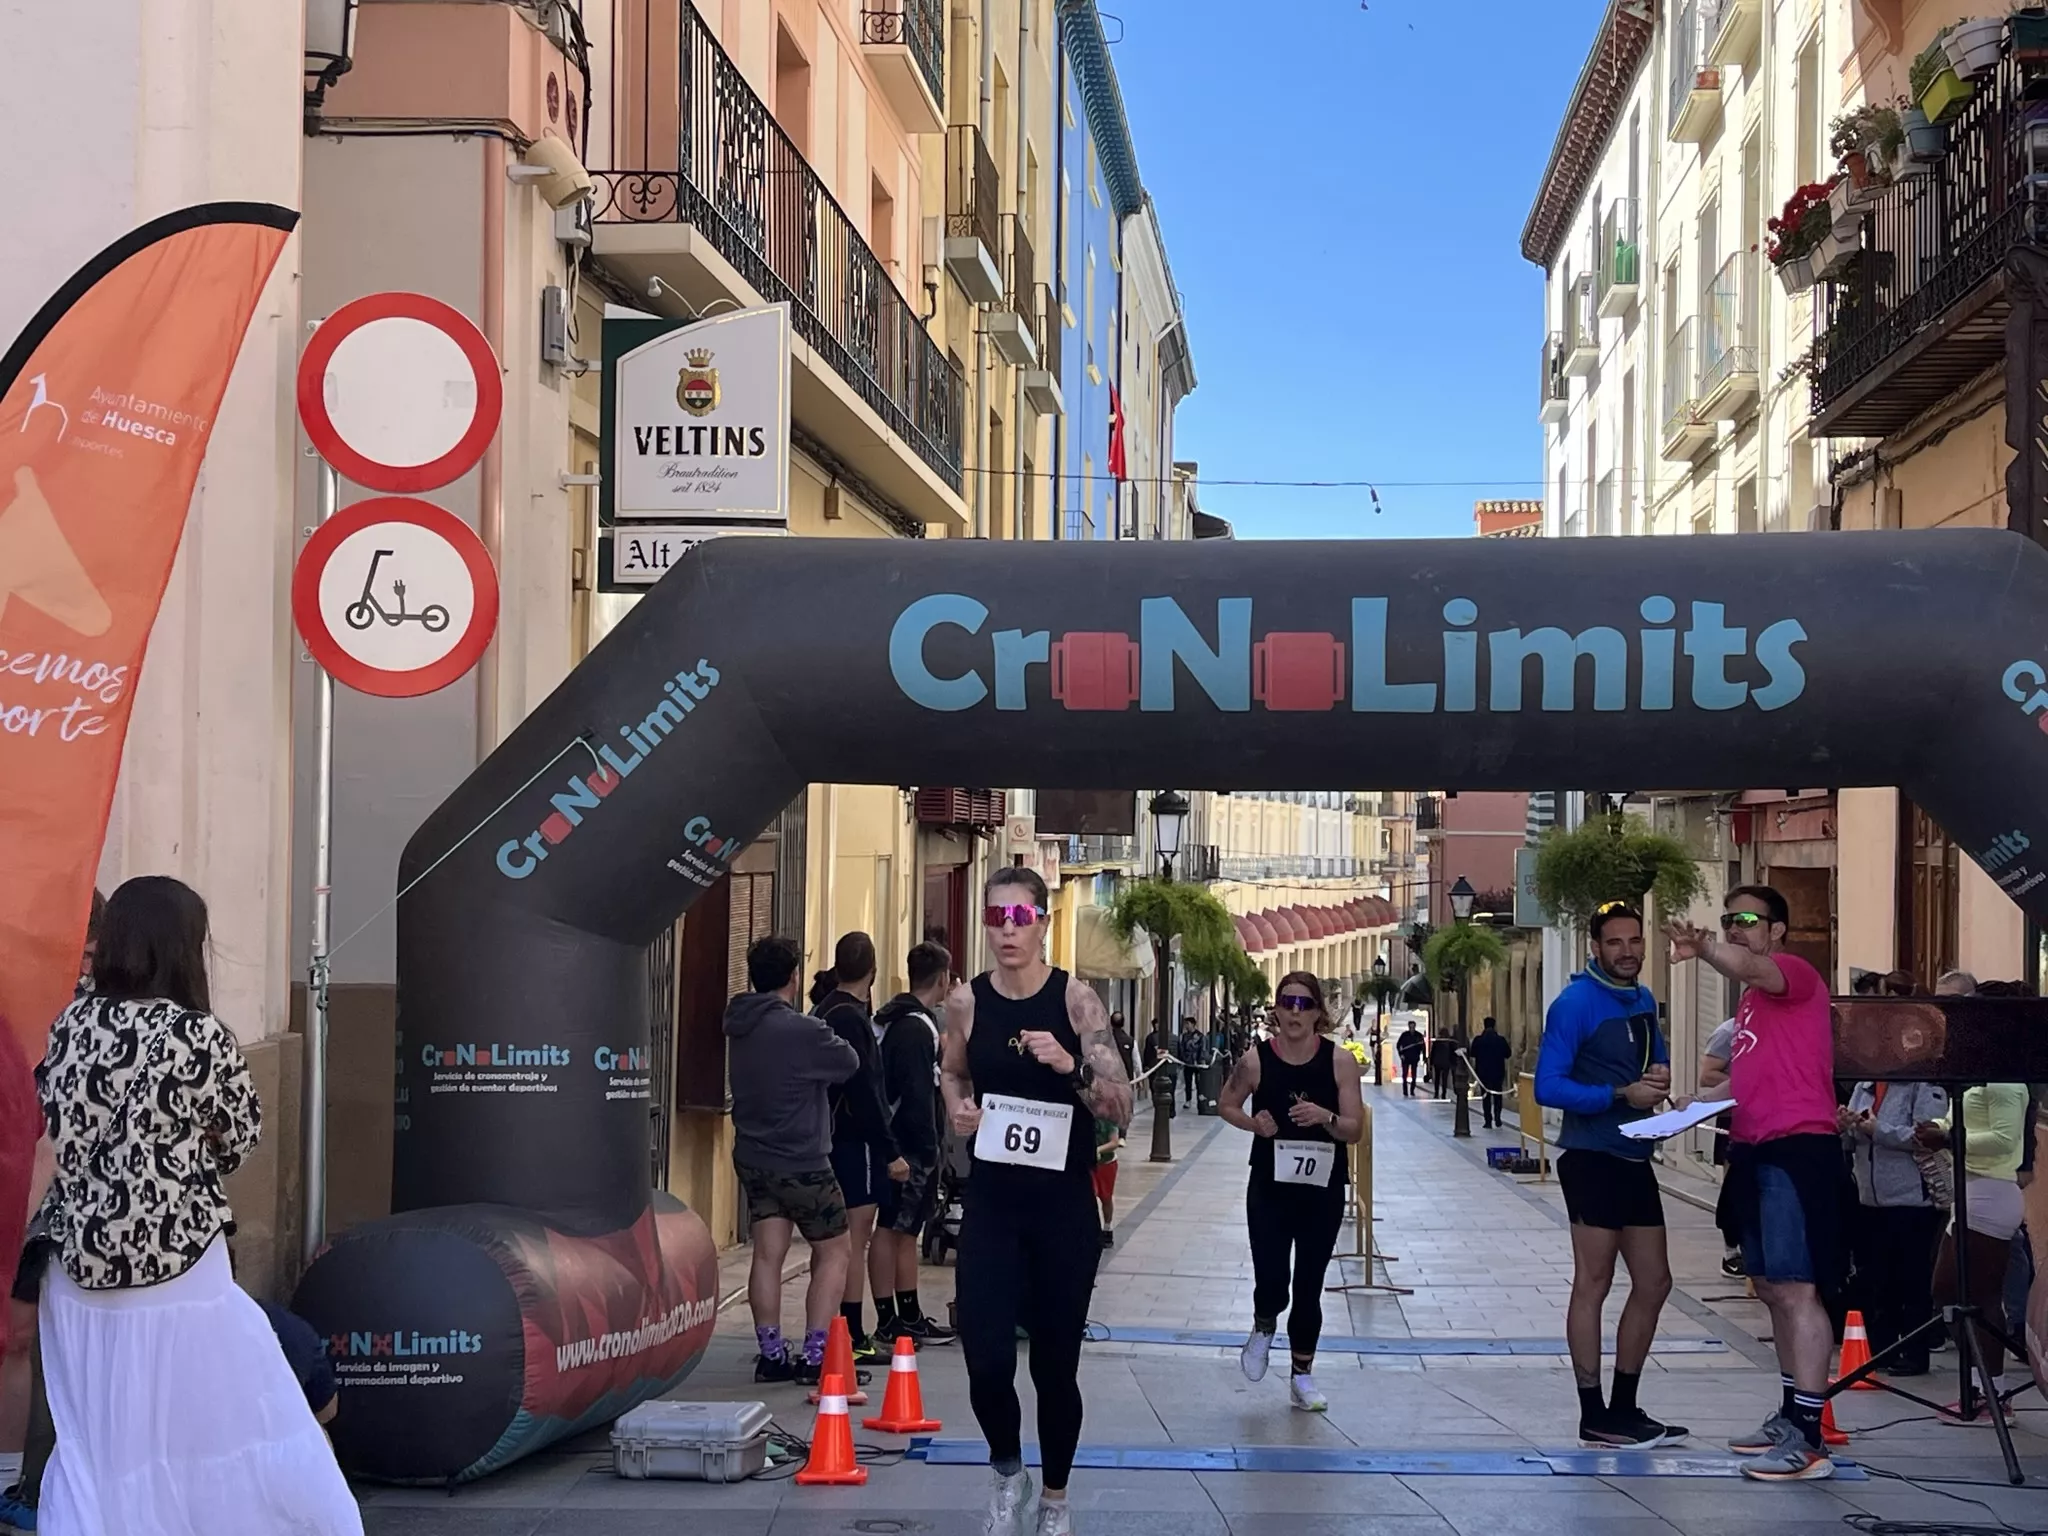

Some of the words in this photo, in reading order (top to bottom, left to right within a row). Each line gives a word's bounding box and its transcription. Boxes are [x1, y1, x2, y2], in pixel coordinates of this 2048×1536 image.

[101, 409, 177, 446] Huesca
[633, 425, 766, 457] VELTINS
[656, 460, 739, 479] Brautradition
[671, 481, 693, 493] seit
[694, 480, 722, 494] 1824
[624, 539, 670, 569] Alt
[0, 696, 111, 741] orte
[433, 1071, 463, 1081] Servicio
[464, 1071, 476, 1080] de
[477, 1071, 540, 1082] cronometraje
[541, 1073, 548, 1084] y
[459, 1083, 470, 1092] de
[471, 1083, 507, 1092] eventos
[508, 1082, 558, 1093] deportivos
[1004, 1123, 1041, 1154] 69
[1293, 1156, 1317, 1176] 70
[335, 1361, 371, 1372] Servicio
[373, 1361, 387, 1372] de
[431, 1362, 440, 1373] y
[344, 1375, 408, 1387] promocional
[409, 1374, 464, 1386] deportivo
